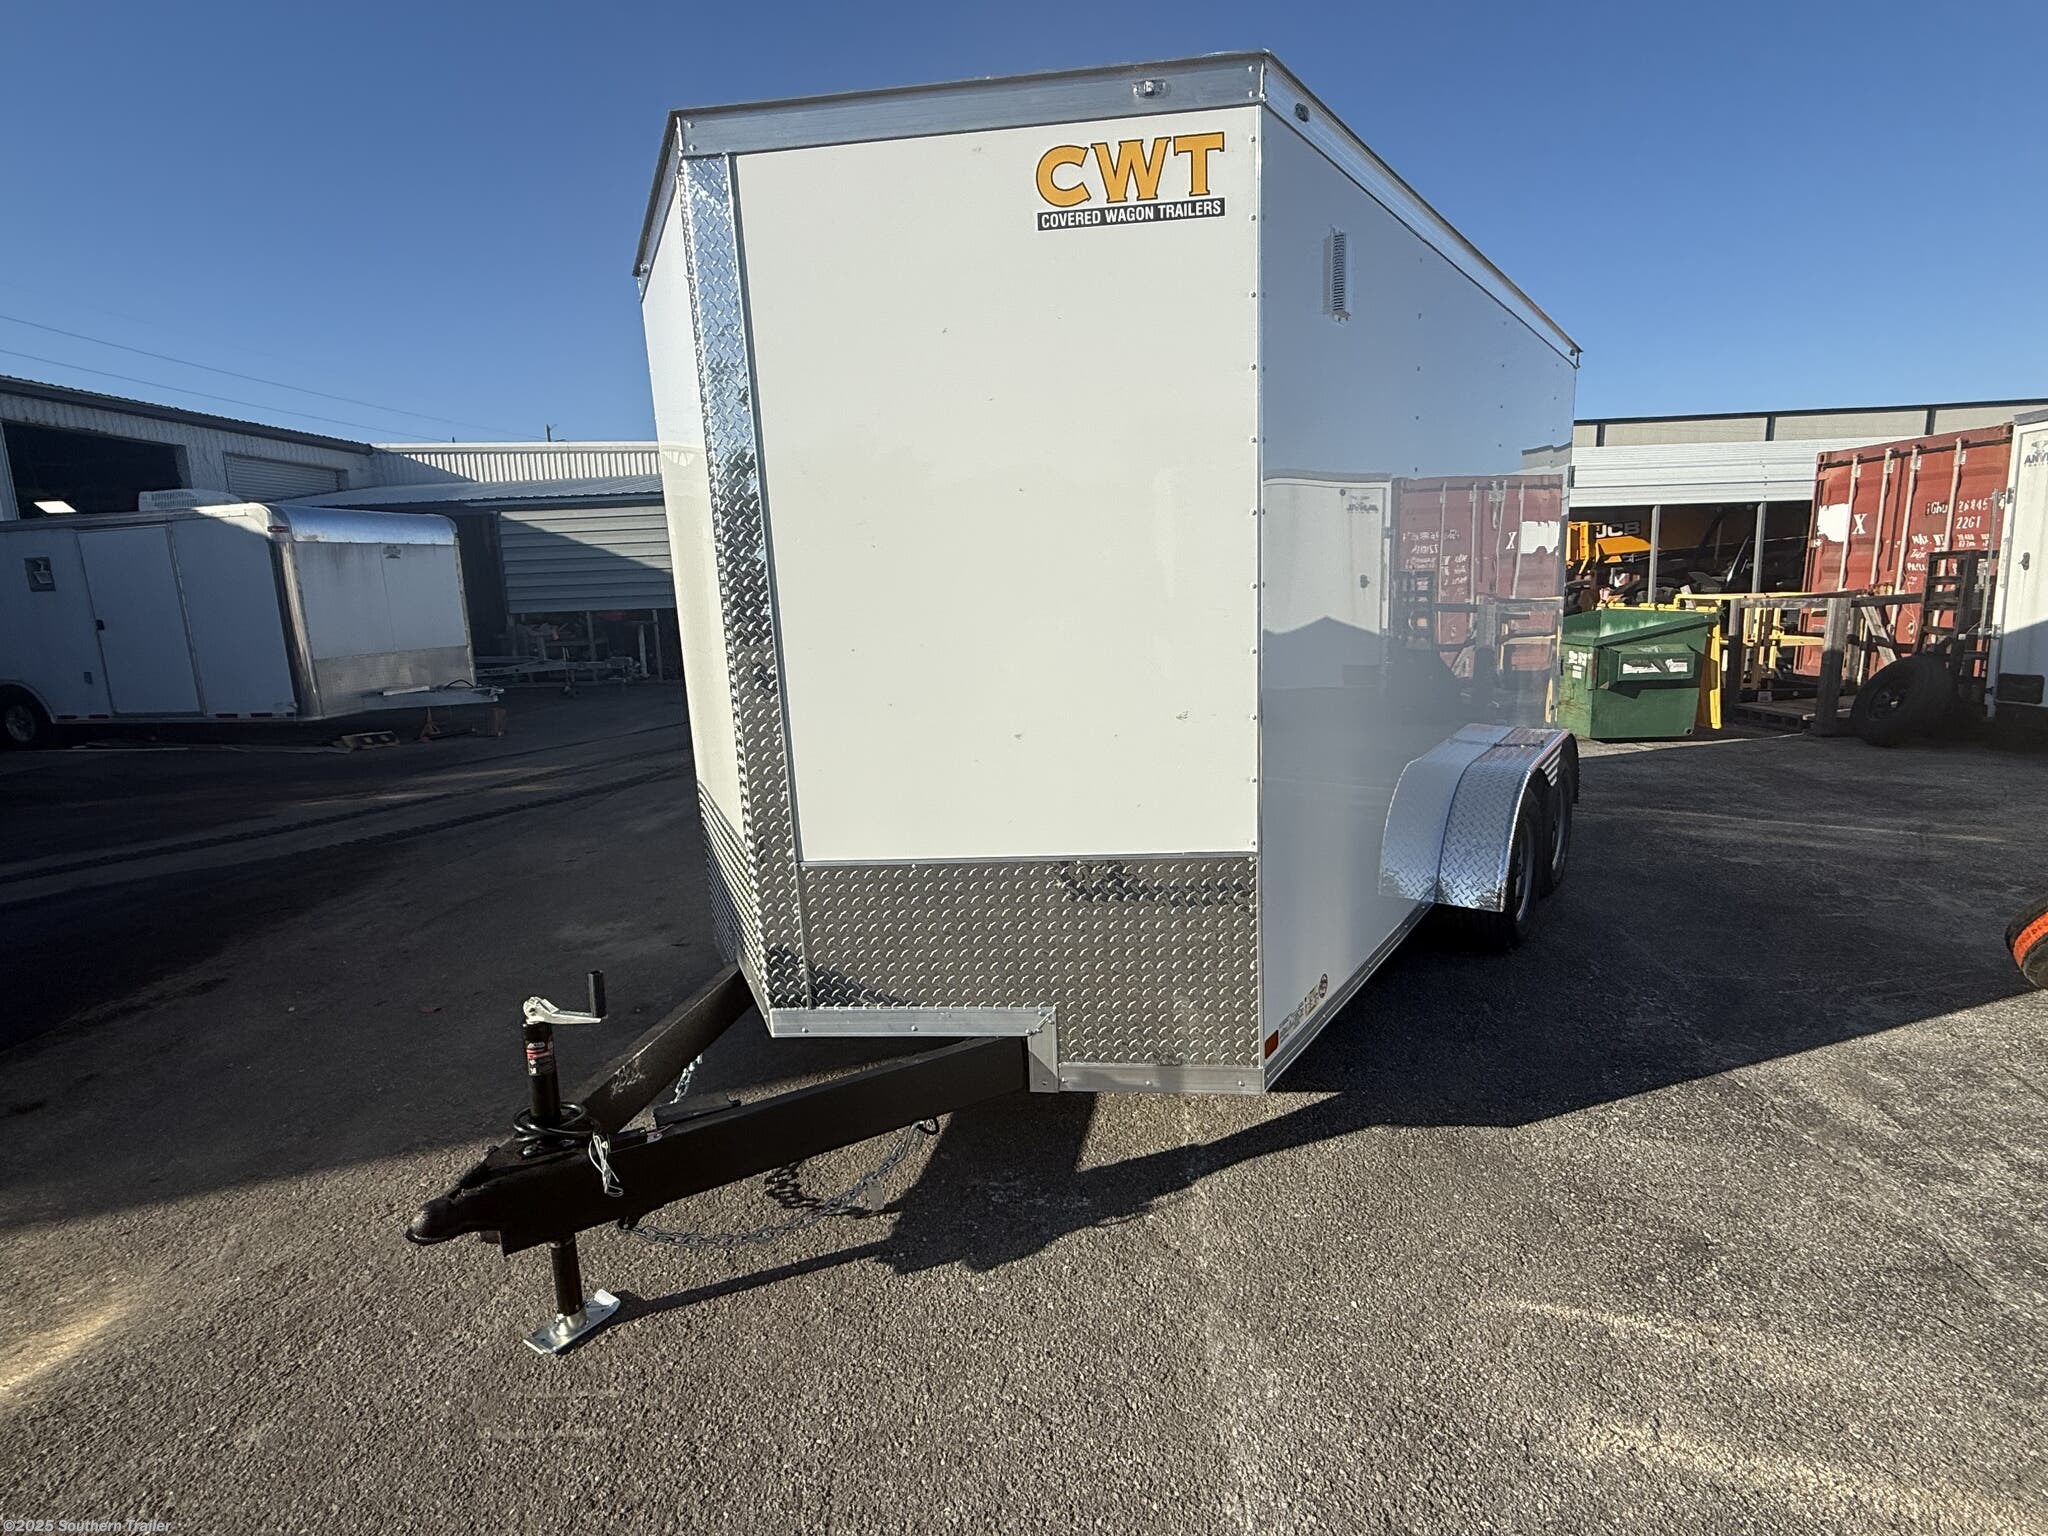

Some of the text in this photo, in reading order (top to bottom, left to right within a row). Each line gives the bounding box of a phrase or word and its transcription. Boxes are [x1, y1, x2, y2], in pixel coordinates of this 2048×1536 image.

[1036, 131, 1225, 208] CWT
[1041, 200, 1221, 229] COVERED WAGON TRAILERS
[1595, 521, 1640, 538] JCB
[1852, 513, 1867, 535] X
